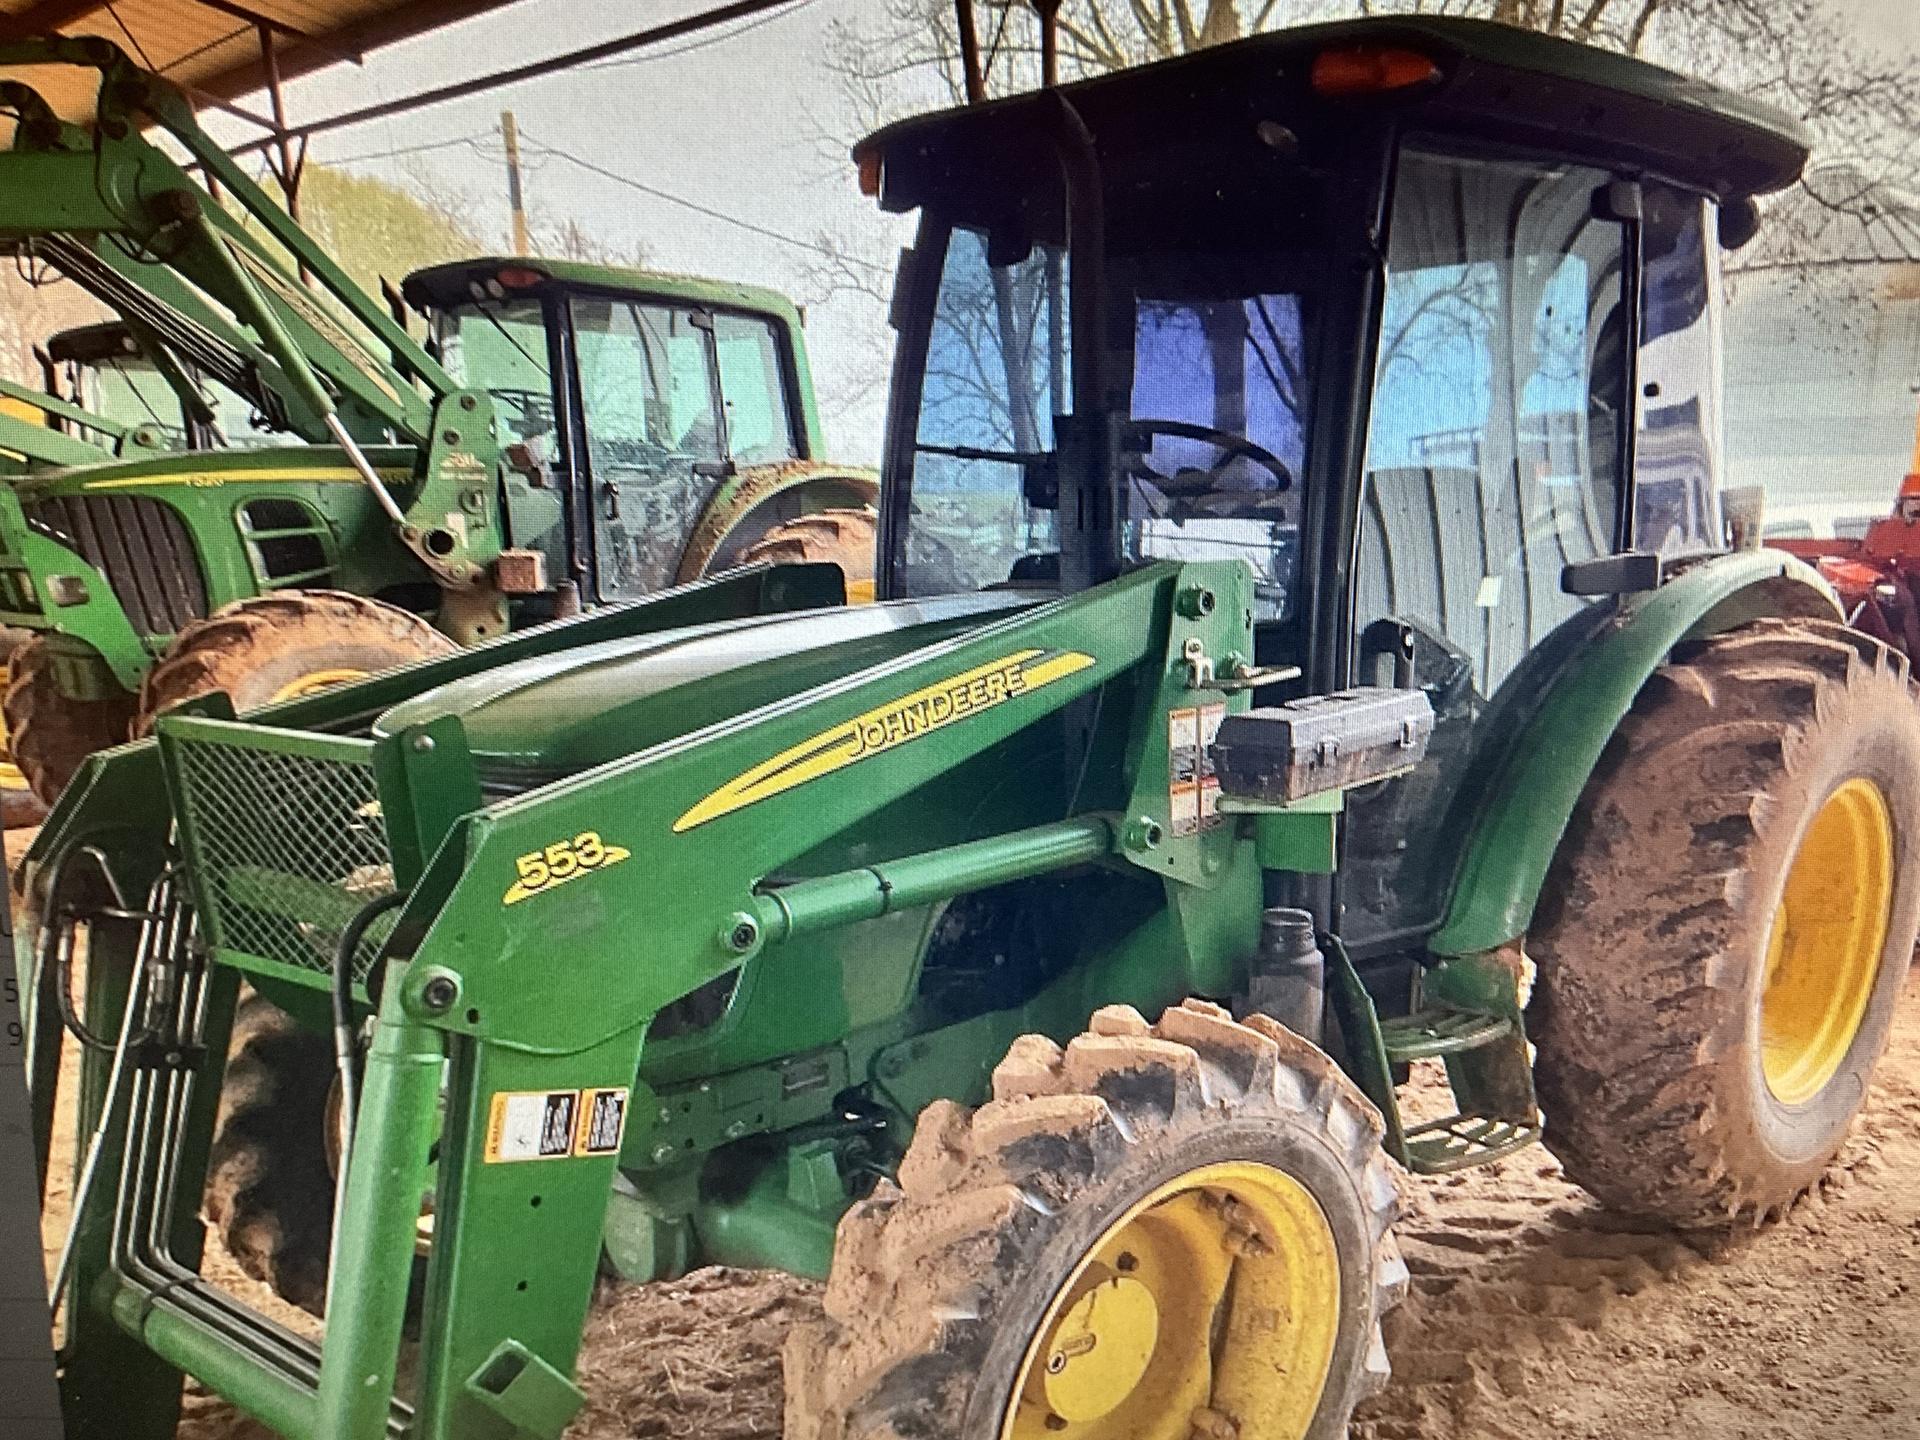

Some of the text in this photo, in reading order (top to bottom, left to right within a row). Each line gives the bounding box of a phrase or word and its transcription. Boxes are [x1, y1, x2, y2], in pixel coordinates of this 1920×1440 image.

[515, 830, 606, 889] 553
[4, 978, 19, 1003] 5
[7, 1022, 23, 1046] 9
